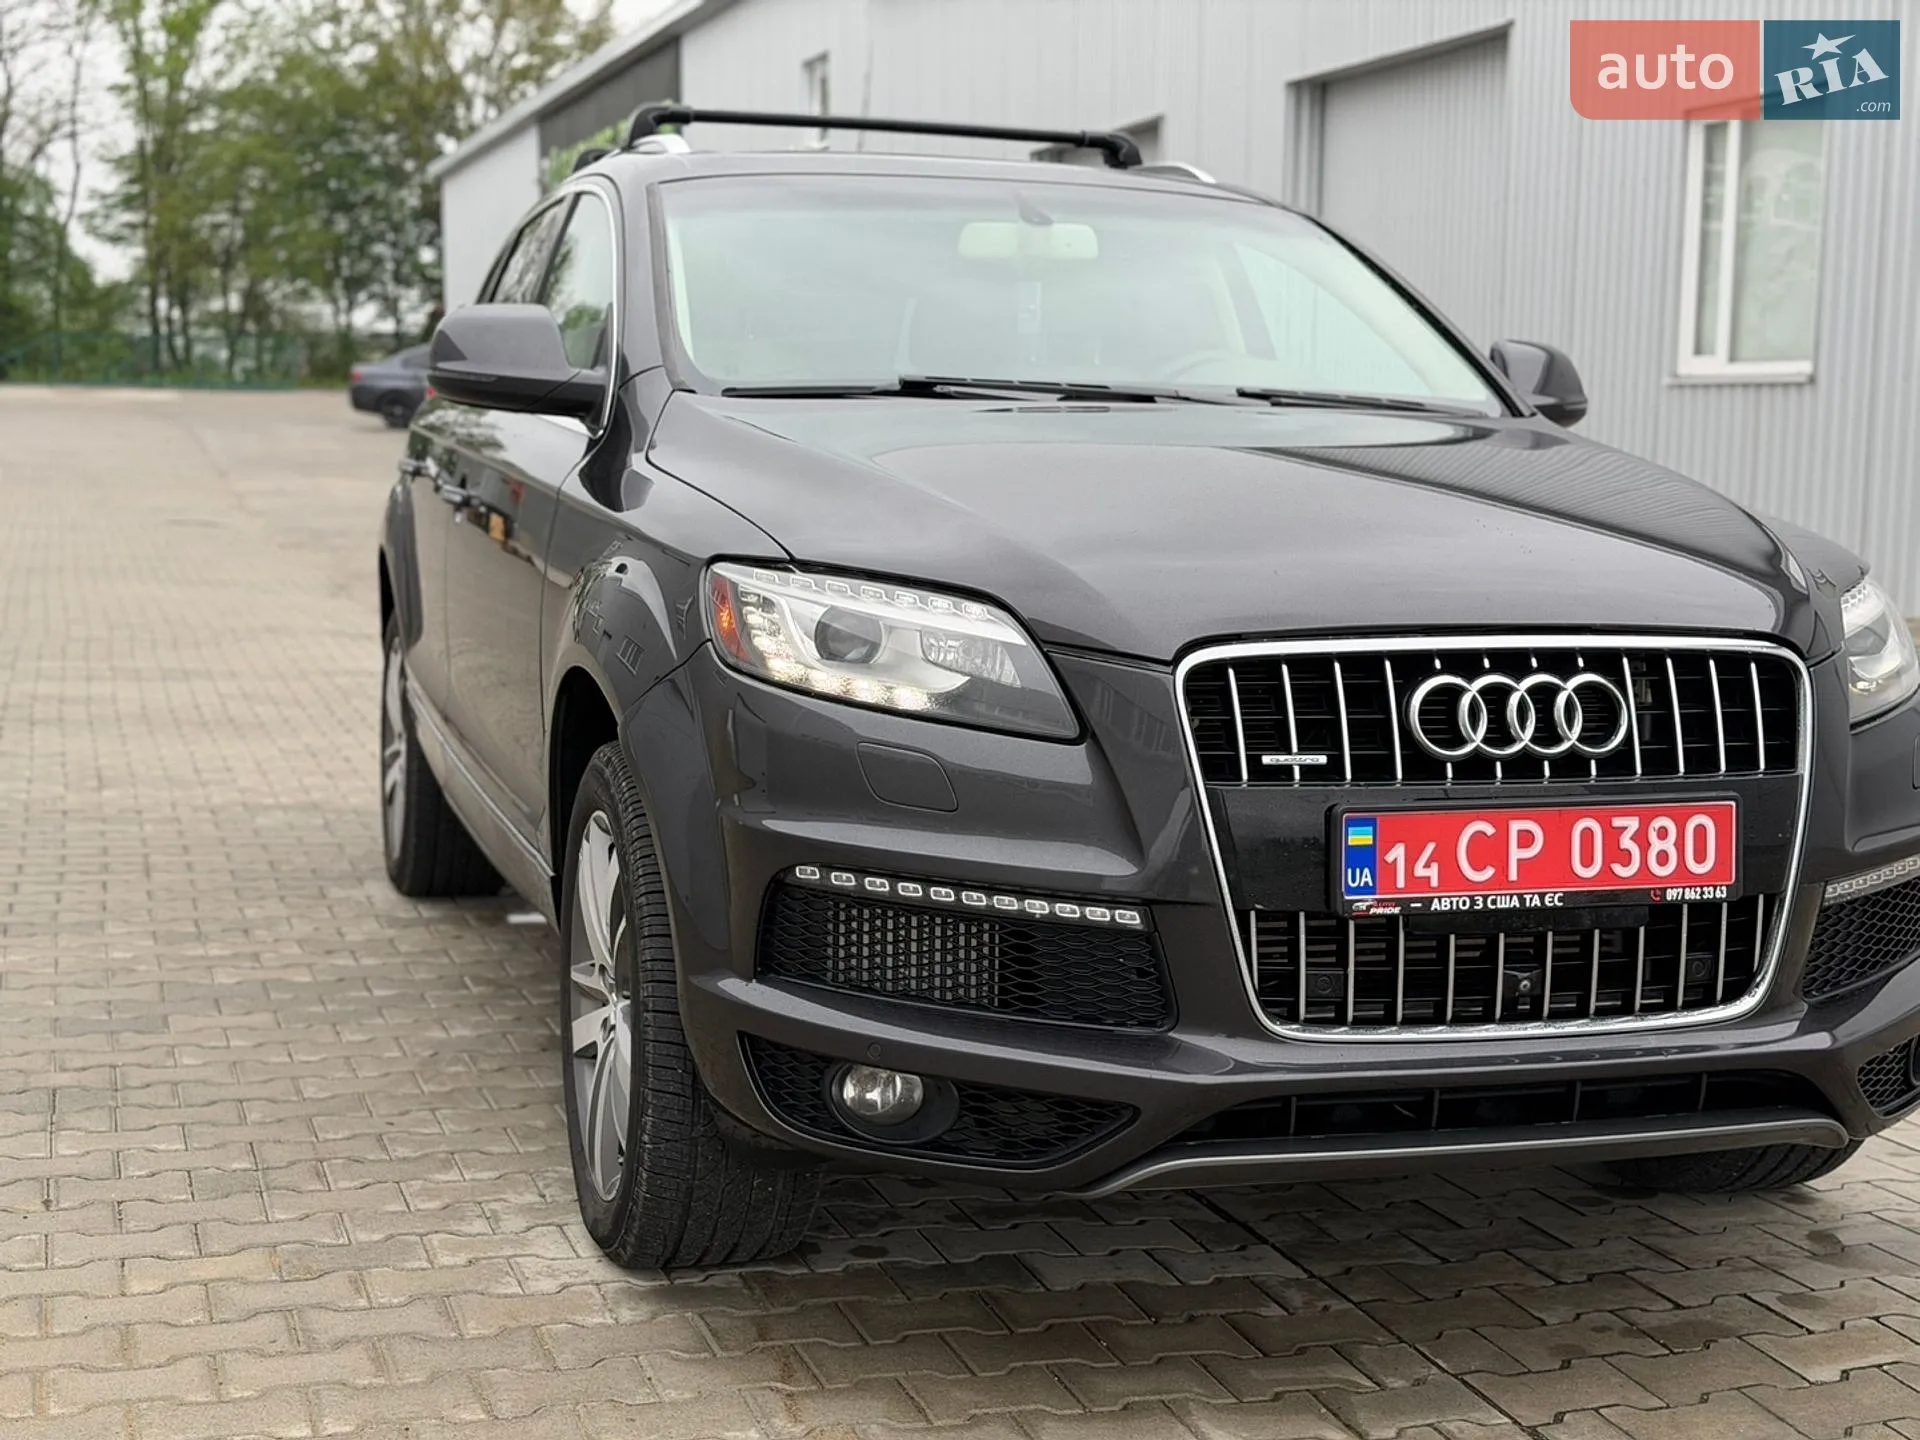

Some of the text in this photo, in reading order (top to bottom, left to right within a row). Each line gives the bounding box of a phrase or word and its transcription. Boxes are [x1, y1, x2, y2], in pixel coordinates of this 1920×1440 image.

[1383, 841, 1440, 889] 14
[1571, 813, 1716, 879] 0380
[1347, 867, 1373, 888] UA
[1431, 896, 1470, 911] АВТО
[1487, 894, 1520, 909] США
[1523, 893, 1541, 907] ТА
[1544, 892, 1564, 907] ЄС
[1666, 885, 1727, 901] 097 862 33 63
[1369, 906, 1401, 915] PRIDE
